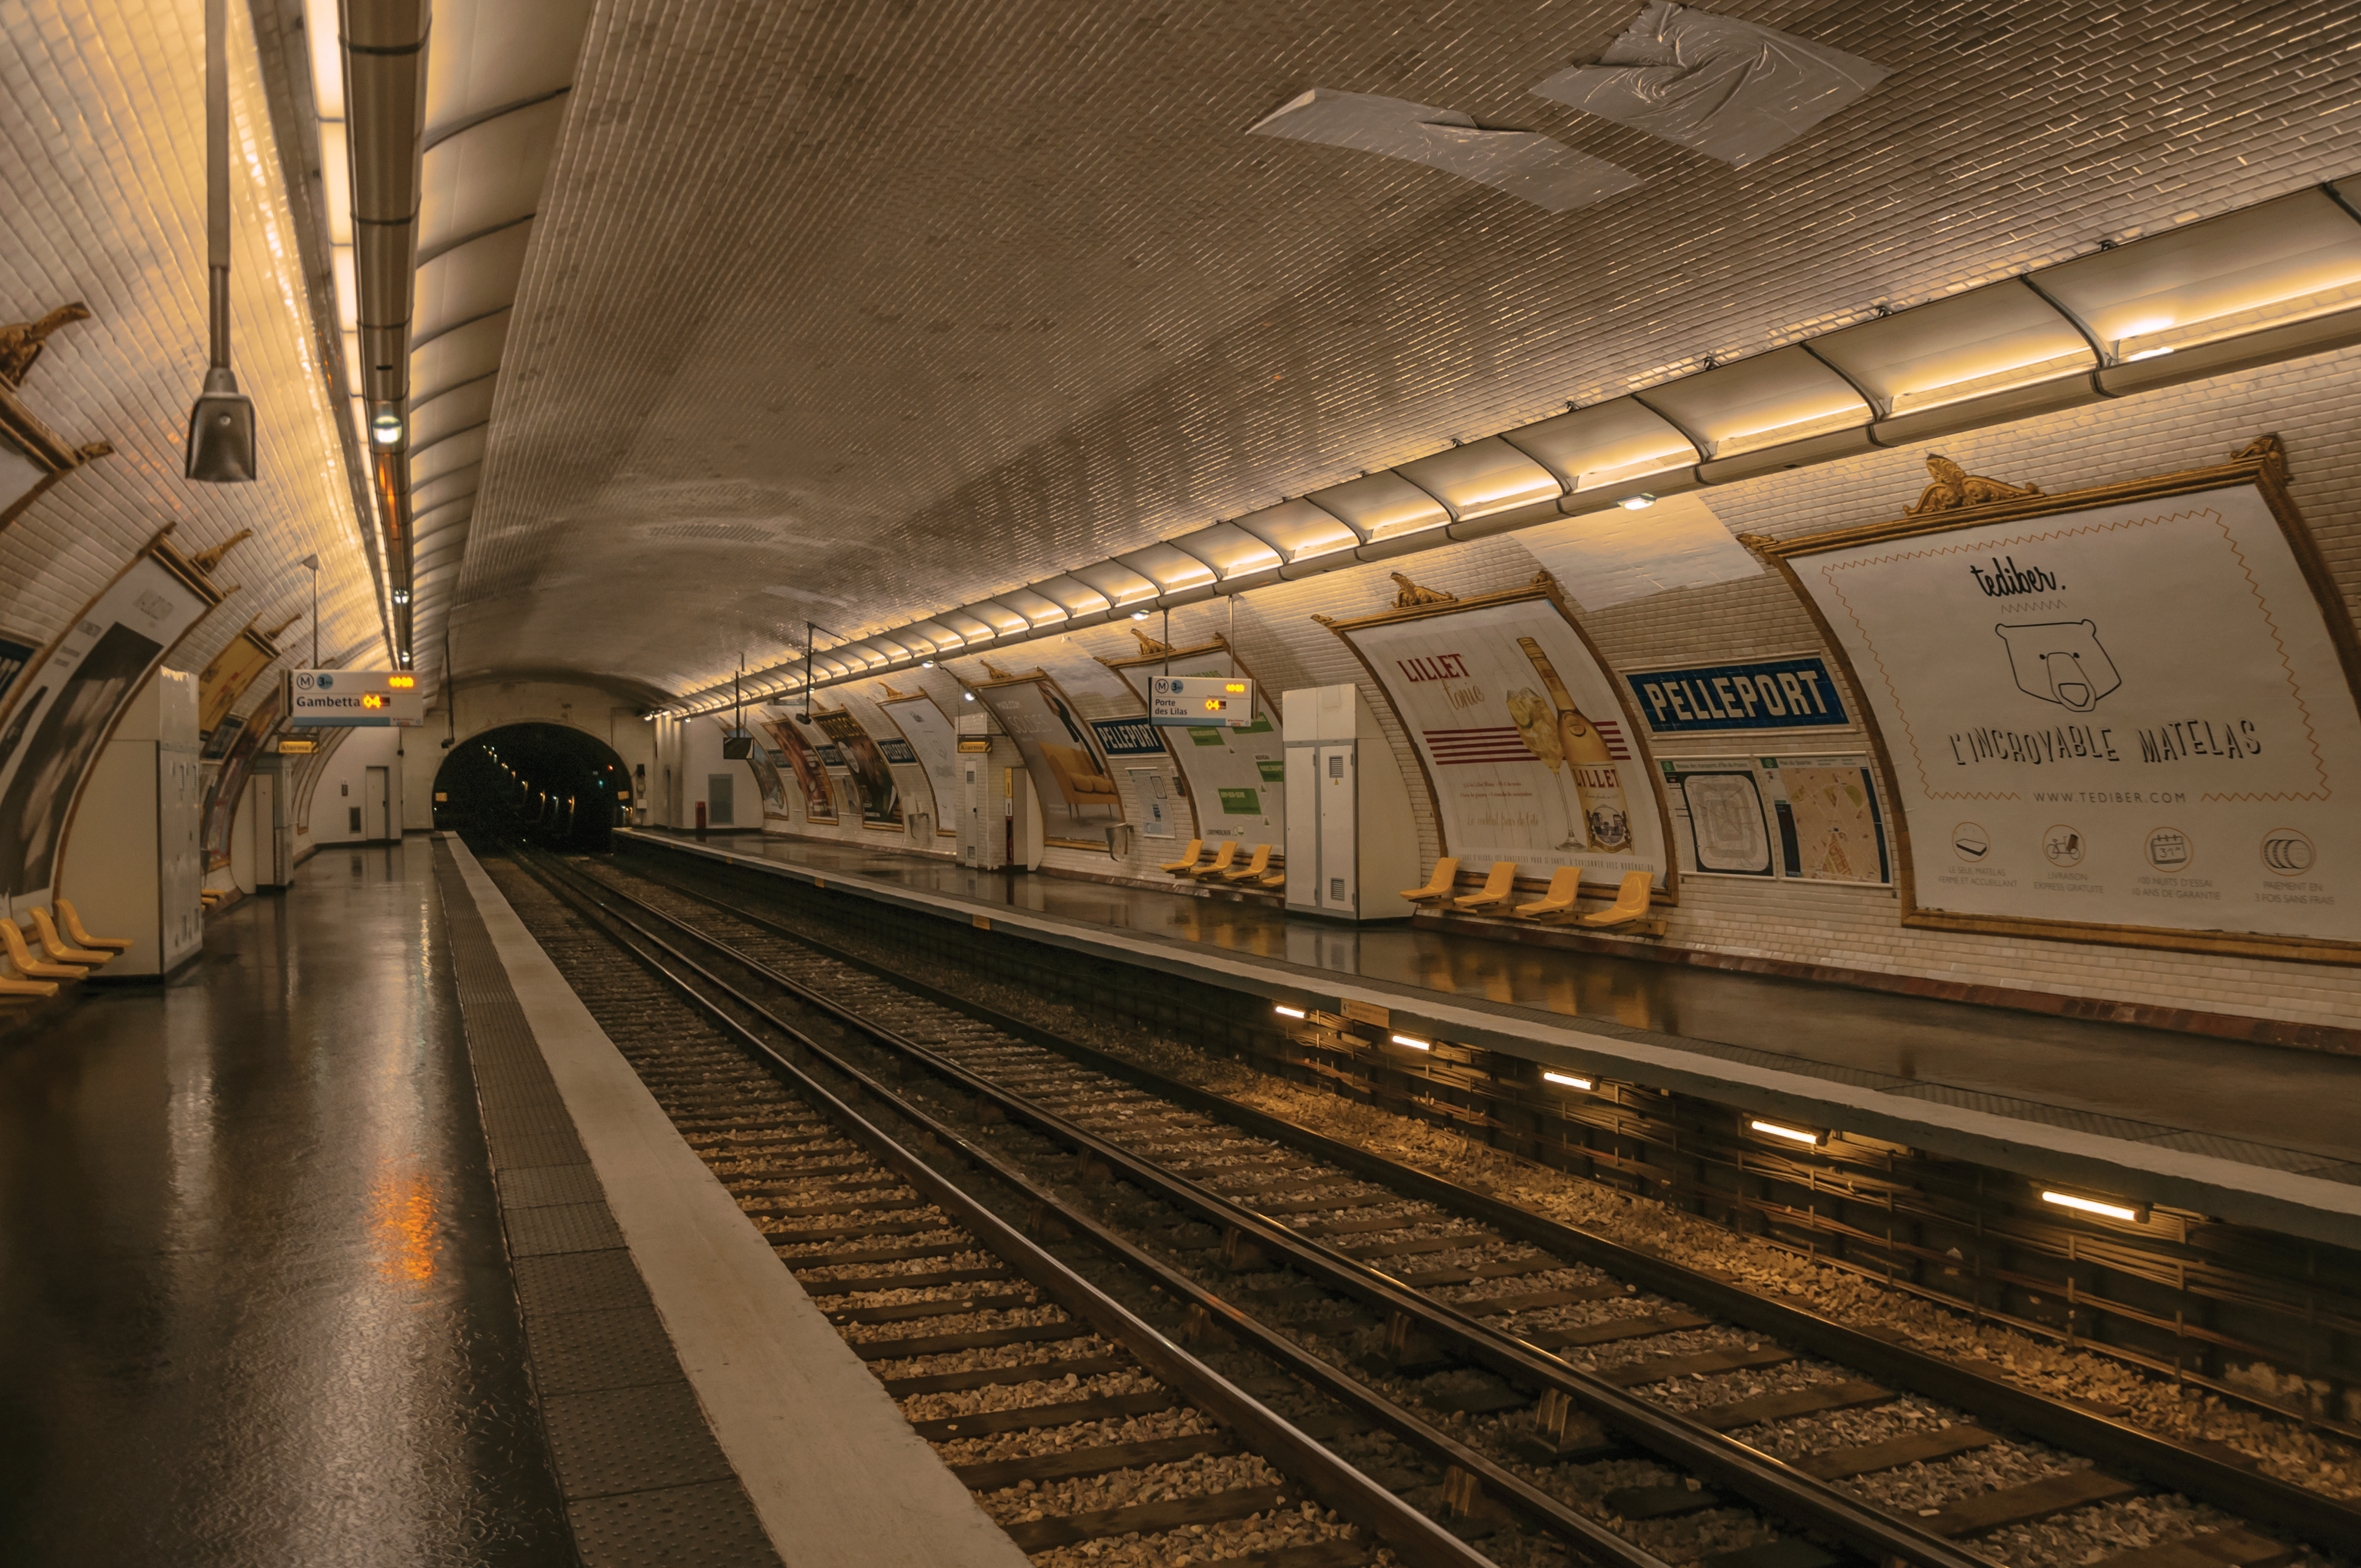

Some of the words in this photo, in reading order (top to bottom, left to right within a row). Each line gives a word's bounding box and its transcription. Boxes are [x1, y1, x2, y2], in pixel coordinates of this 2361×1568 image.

[1970, 556, 2066, 597] tediber.
[1396, 654, 1470, 682] LILLET
[1441, 678, 1485, 710] tonic
[1644, 671, 1827, 721] PELLEPORT
[297, 696, 360, 707] Gambetta
[1205, 700, 1219, 710] 04
[1007, 714, 1052, 733] SOLDES
[1097, 724, 1159, 748] PELLEPORT
[1948, 723, 2120, 766] L'INCROYABLE
[2138, 717, 2261, 763] MATELAS
[1572, 769, 1619, 788] LILLET
[2033, 791, 2186, 803] WWW.TEDIBER.COM
[1957, 867, 1973, 875] SEUL
[1975, 867, 2006, 877] MATELAS
[2047, 872, 2089, 881] LIVRAISON
[1938, 875, 1959, 884] FERME
[1961, 876, 1968, 884] ET
[1971, 877, 2017, 888] ACCUEILLANT
[2033, 881, 2065, 891] EXPRESS
[2066, 883, 2104, 894] GRATUITE
[2137, 877, 2151, 885] 100
[2152, 877, 2177, 887] NUITS
[2179, 878, 2213, 888] D'ESSAI
[2263, 881, 2306, 891] PAIEMENT
[2309, 882, 2324, 892] EN
[2132, 888, 2141, 896] 10
[2143, 888, 2159, 897] ANS
[2161, 889, 2174, 898] DE
[2176, 889, 2221, 901] GARANTIE
[2254, 893, 2260, 902] 3
[2261, 893, 2280, 903] FOIS
[2283, 894, 2307, 904] SANS
[2309, 894, 2334, 905] FRAIS
